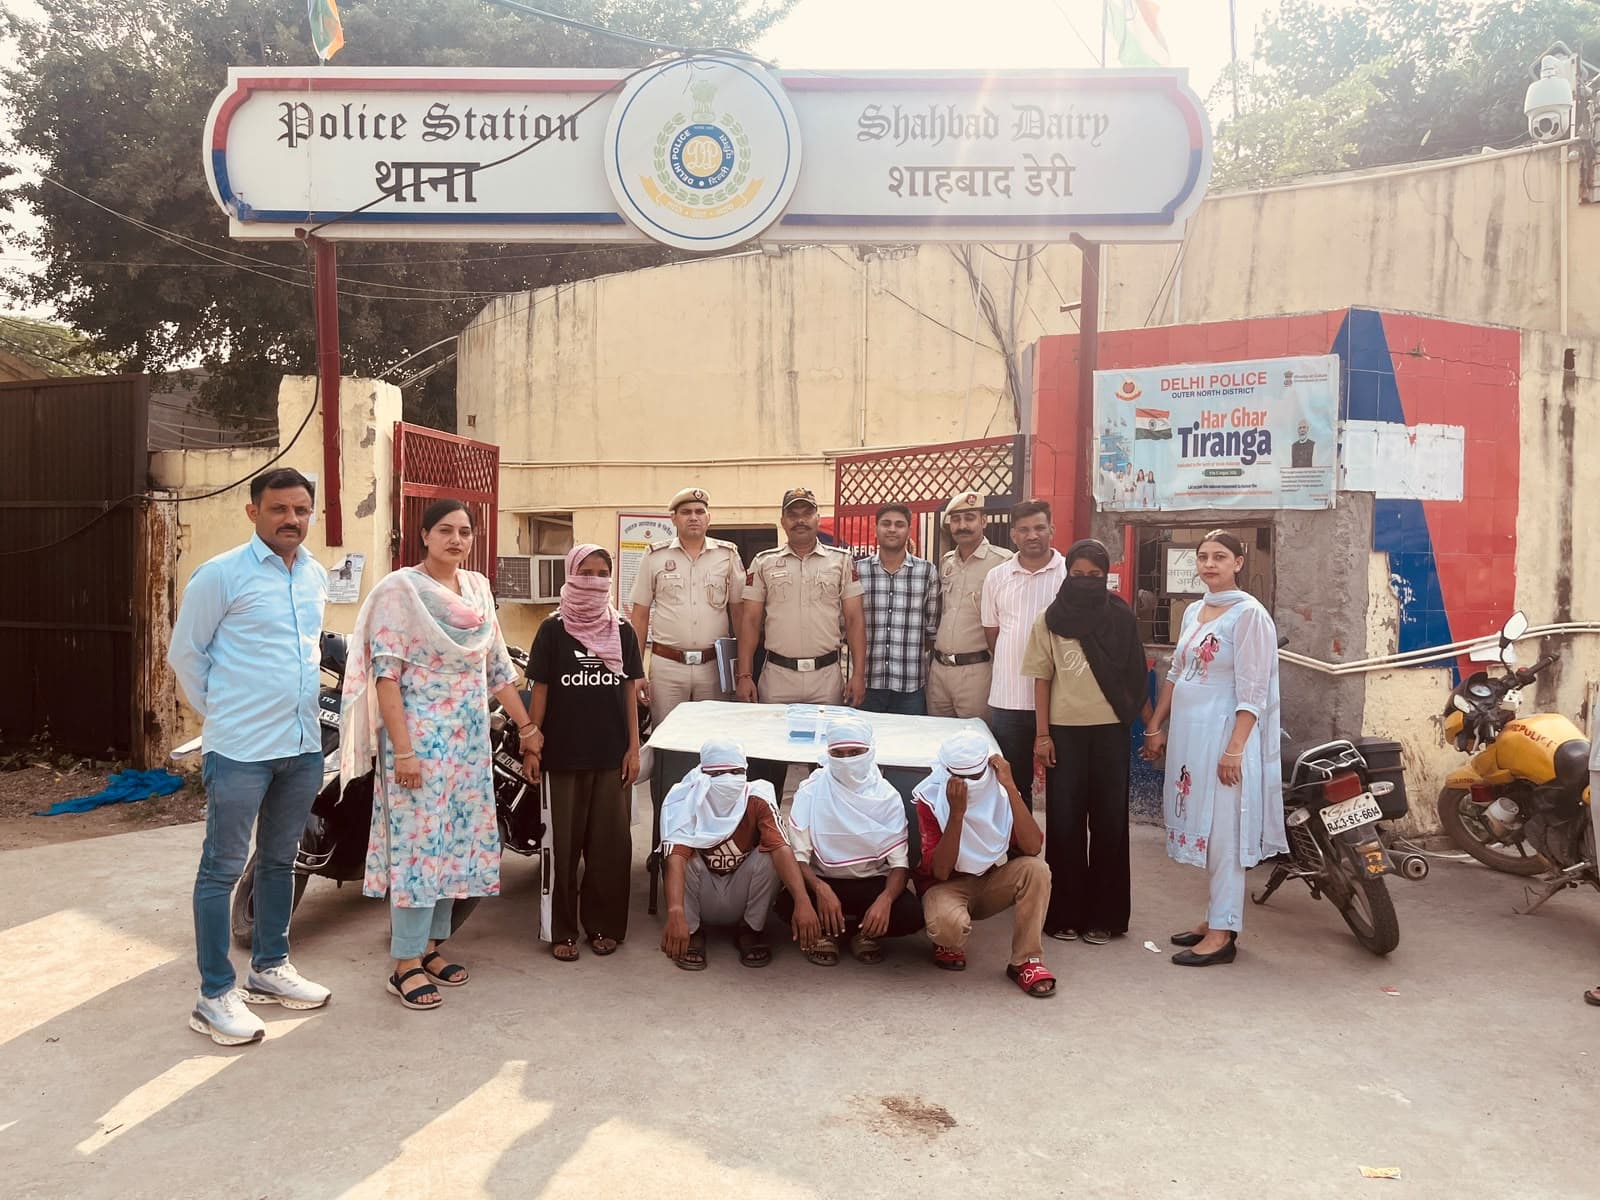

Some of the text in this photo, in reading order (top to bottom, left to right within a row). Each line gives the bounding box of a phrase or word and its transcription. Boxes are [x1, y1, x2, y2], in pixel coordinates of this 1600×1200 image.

[277, 102, 579, 148] Police Station
[856, 103, 1109, 148] Shahbad Dairy
[671, 129, 691, 160] POLICE
[375, 160, 481, 203] थाना
[673, 162, 695, 185] DELHI
[888, 152, 1076, 203] शाहबाद डेरी
[1160, 371, 1268, 392] DELHI POLICE
[1171, 386, 1255, 399] OUTER NORTH DISTRICT
[1200, 406, 1268, 429] Har Ghar
[1177, 420, 1272, 466] Tiranga
[561, 670, 621, 687] adidas
